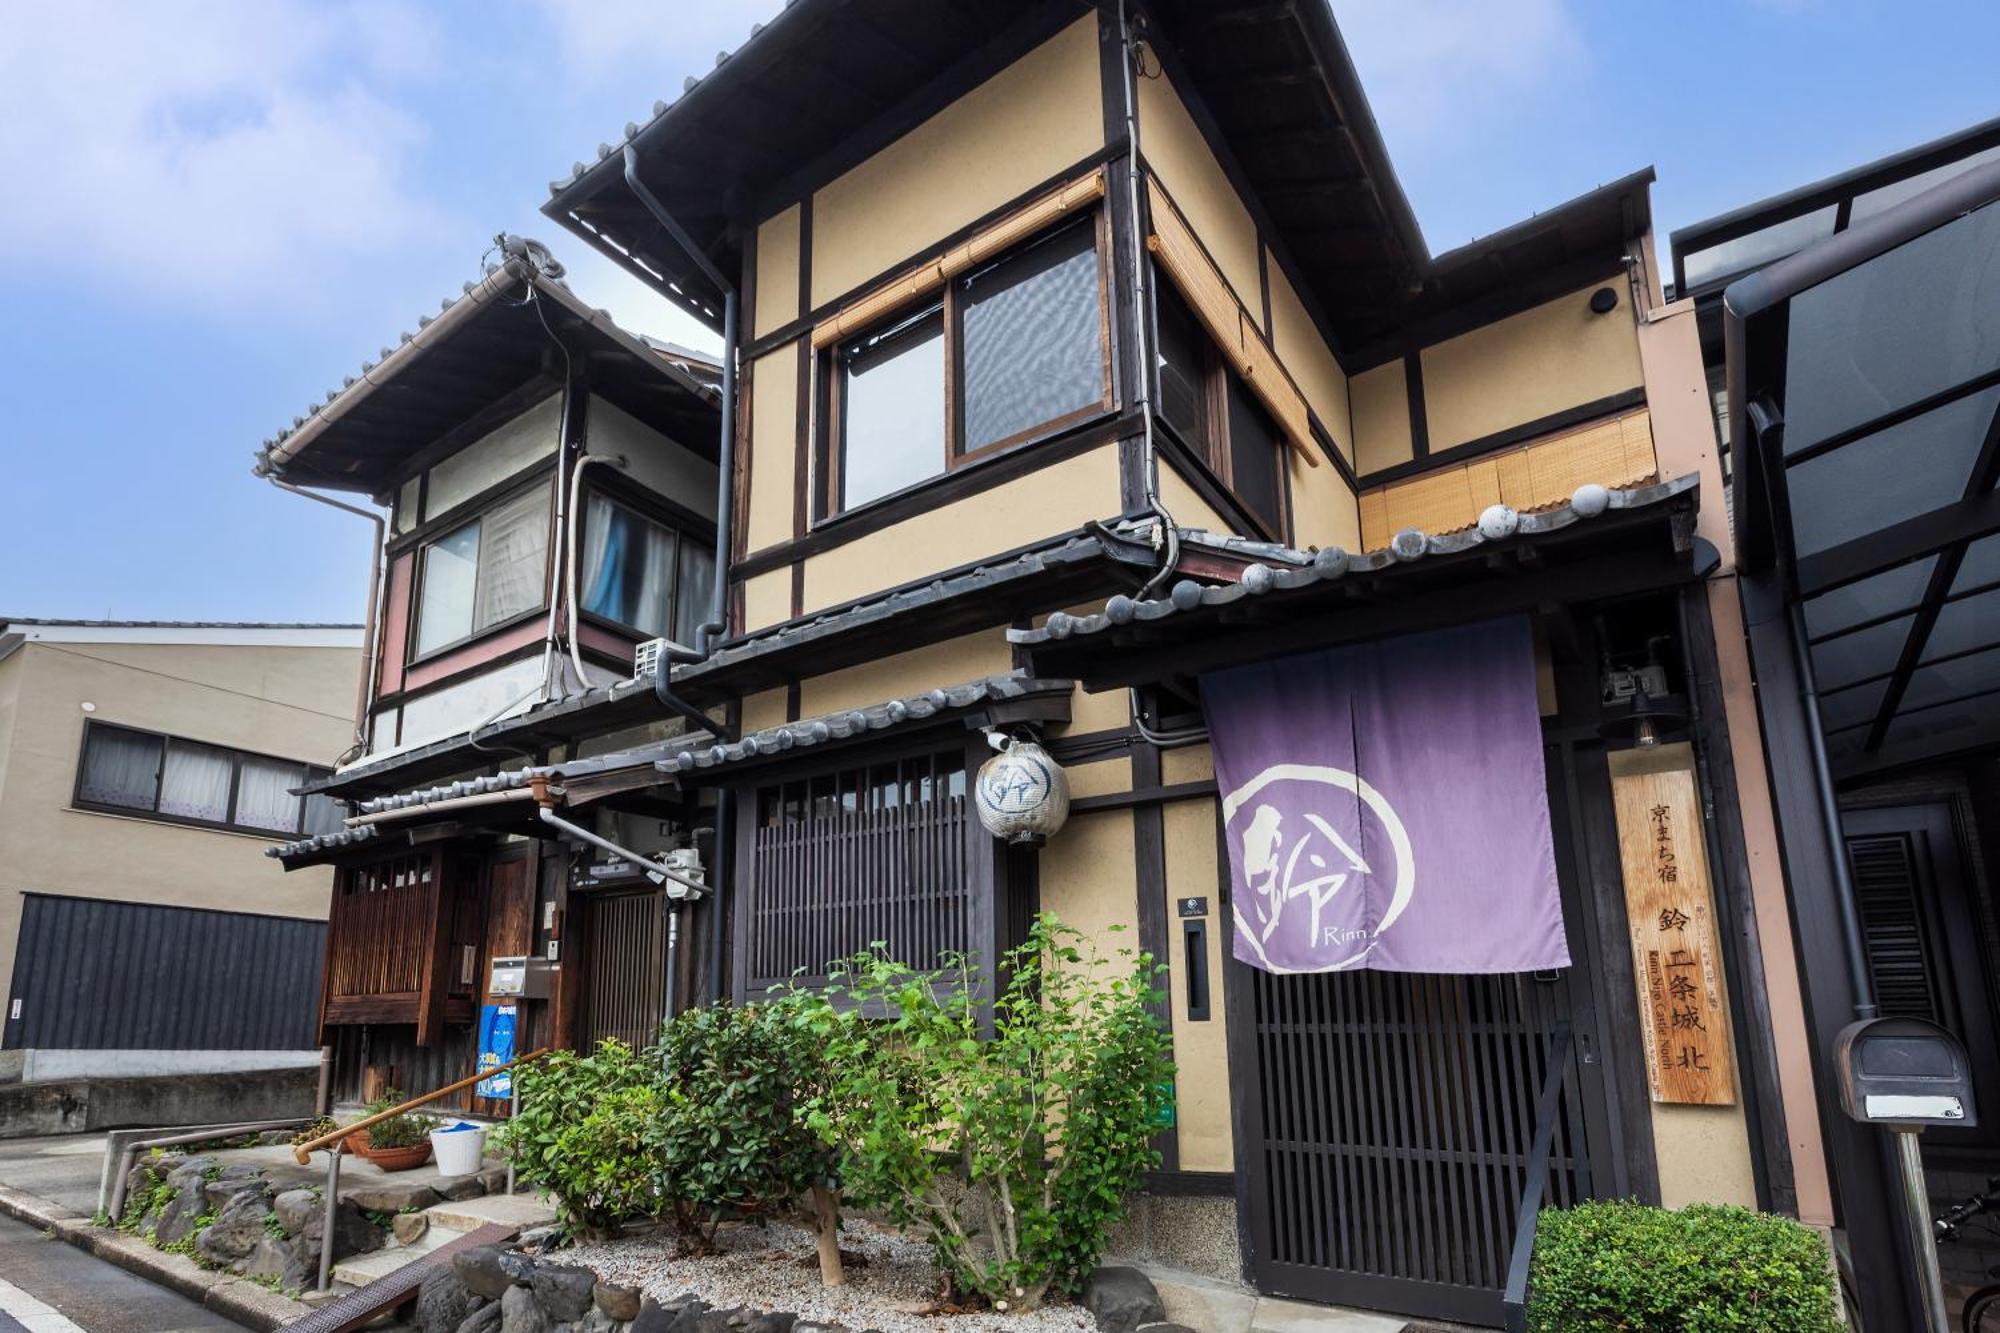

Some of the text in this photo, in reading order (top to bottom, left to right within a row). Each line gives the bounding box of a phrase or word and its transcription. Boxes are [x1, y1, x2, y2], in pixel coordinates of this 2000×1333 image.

[1650, 803, 1677, 884] 京まち宿
[1659, 908, 1690, 932] 鈴
[1323, 926, 1367, 947] Rinn
[1655, 1003, 1669, 1035] Castle
[1660, 1040, 1675, 1070] North
